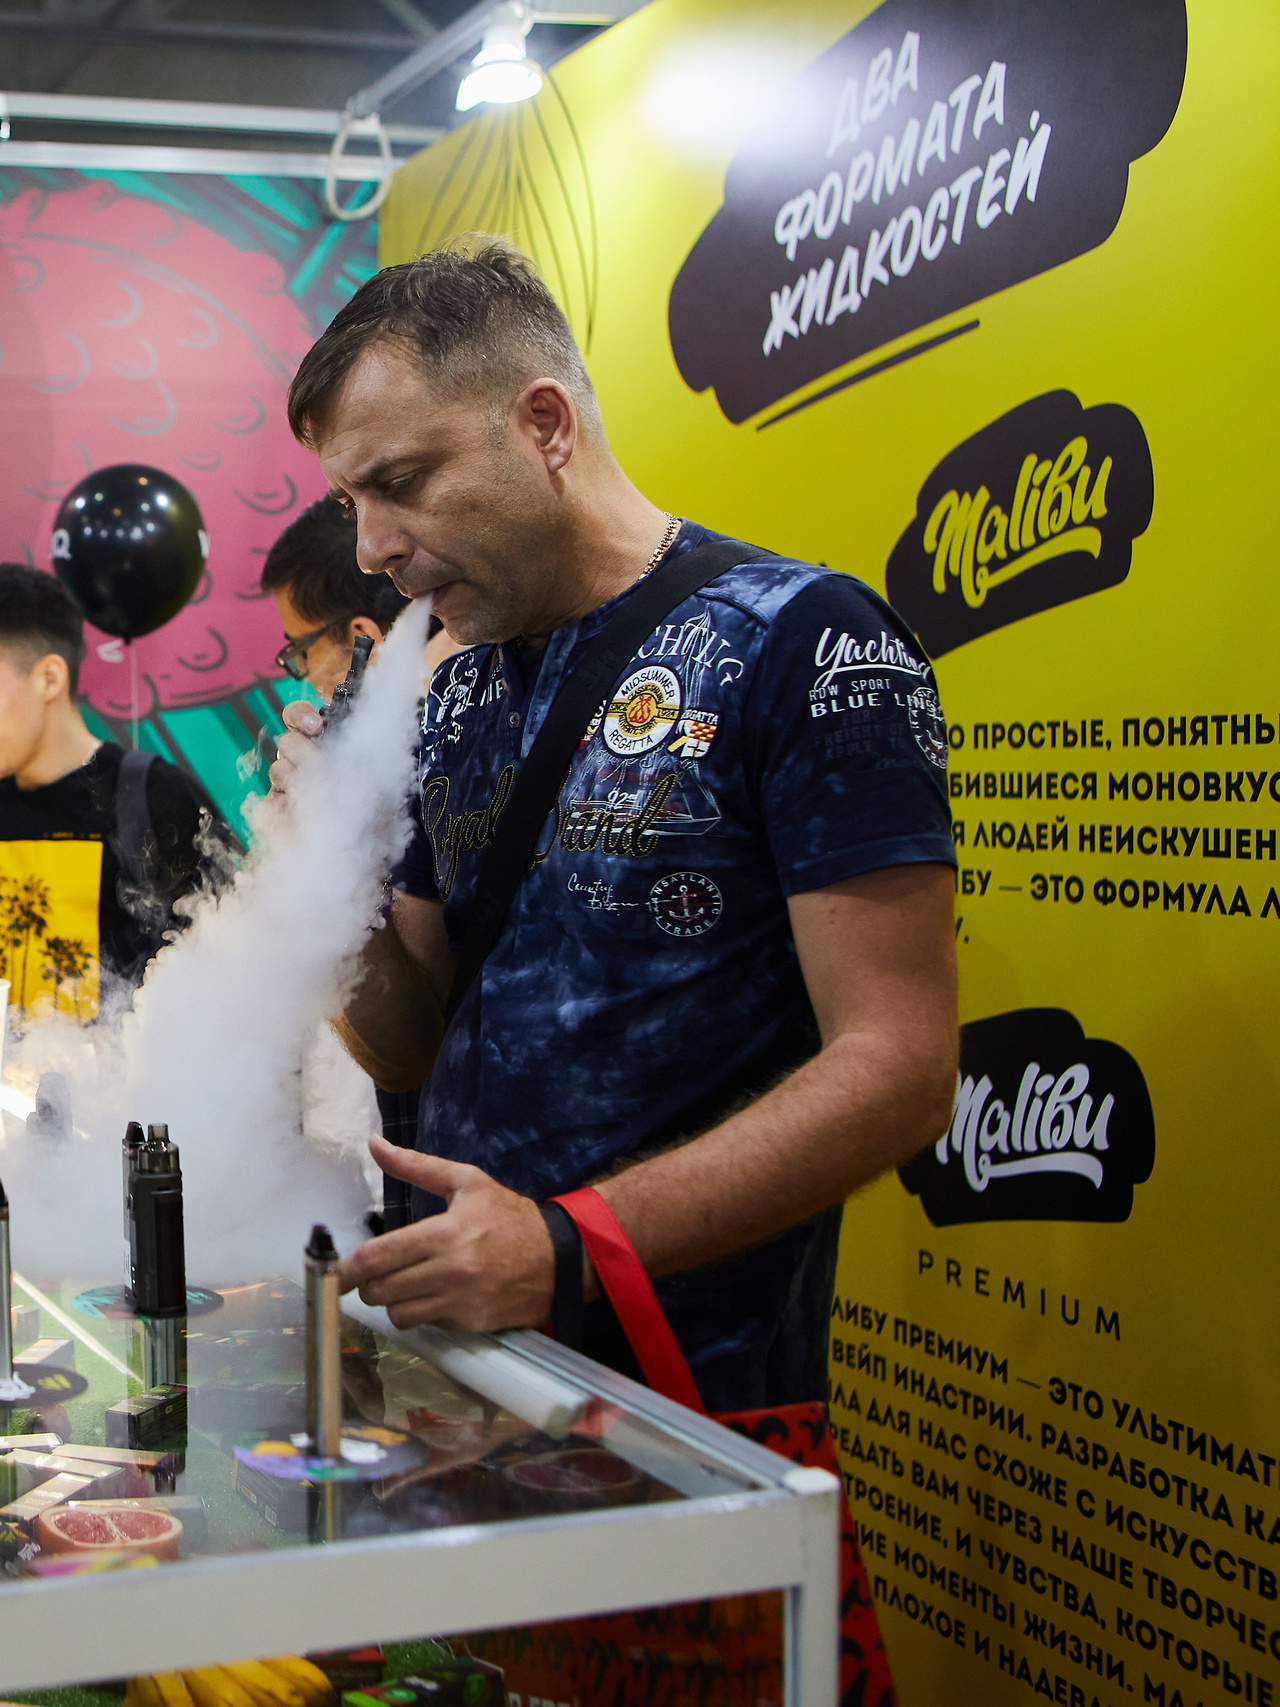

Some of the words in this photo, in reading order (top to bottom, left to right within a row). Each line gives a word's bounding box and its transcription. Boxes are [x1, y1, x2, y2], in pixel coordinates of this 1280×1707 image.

[825, 31, 920, 158] ДВА
[775, 61, 1006, 261] ФОРМАТА
[762, 110, 1051, 357] ЖИДКОСТЕЙ
[924, 437, 1112, 608] Malibu
[621, 669, 675, 700] MIDSUMMER
[811, 692, 882, 718] BLUE
[851, 678, 891, 692] SPORT
[973, 719, 1111, 751] ПРОСТЫЕ,
[609, 729, 654, 751] REGATTA
[949, 772, 1097, 800] БИВШИЕСЯ
[973, 815, 1069, 852] ЛЮДЕЙ
[1078, 823, 1277, 861] НЕИСКУШЕН
[664, 919, 713, 936] TRADE
[955, 869, 992, 896] БУ
[1030, 873, 1084, 904] ЭТО
[1093, 877, 1252, 918] ФОРМУЛА
[936, 1062, 1115, 1192] Malibu
[919, 1248, 1122, 1341] PREMIUM
[831, 1296, 887, 1335] ЛИБУ
[894, 1317, 1008, 1384] ПРЕМИУМ
[1049, 1377, 1104, 1420] ЭТО
[1112, 1397, 1280, 1487] УЛЬТИМАТ
[832, 1338, 887, 1382] ВЕЙП
[894, 1362, 1032, 1443] ИНДСТРИИ.
[1041, 1421, 1234, 1528] РАЗРАБОТКА
[829, 1378, 861, 1416] ЛА
[866, 1397, 910, 1437] ДЛЯ
[919, 1417, 967, 1460] НАС
[974, 1444, 1067, 1507] СХОЖЕ
[1076, 1488, 1096, 1519] С
[1106, 1498, 1278, 1601] ИСКУССТВ
[912, 1460, 959, 1506] ВАМ
[968, 1485, 1042, 1545] ЧЕРЕЗ
[1052, 1524, 1134, 1590] НАШЕ
[854, 1520, 887, 1559] ИЕ
[894, 1541, 1015, 1629] МОМЕНТЫ
[1024, 1608, 1134, 1693] ЖИЗНИ.
[875, 1574, 966, 1648] ПЛОХОЕ
[974, 1629, 990, 1662] И
[956, 1527, 971, 1558] И
[980, 1538, 1106, 1631] ЧУВСТВА,
[1116, 1606, 1273, 1707] КОТОРЫЕ
